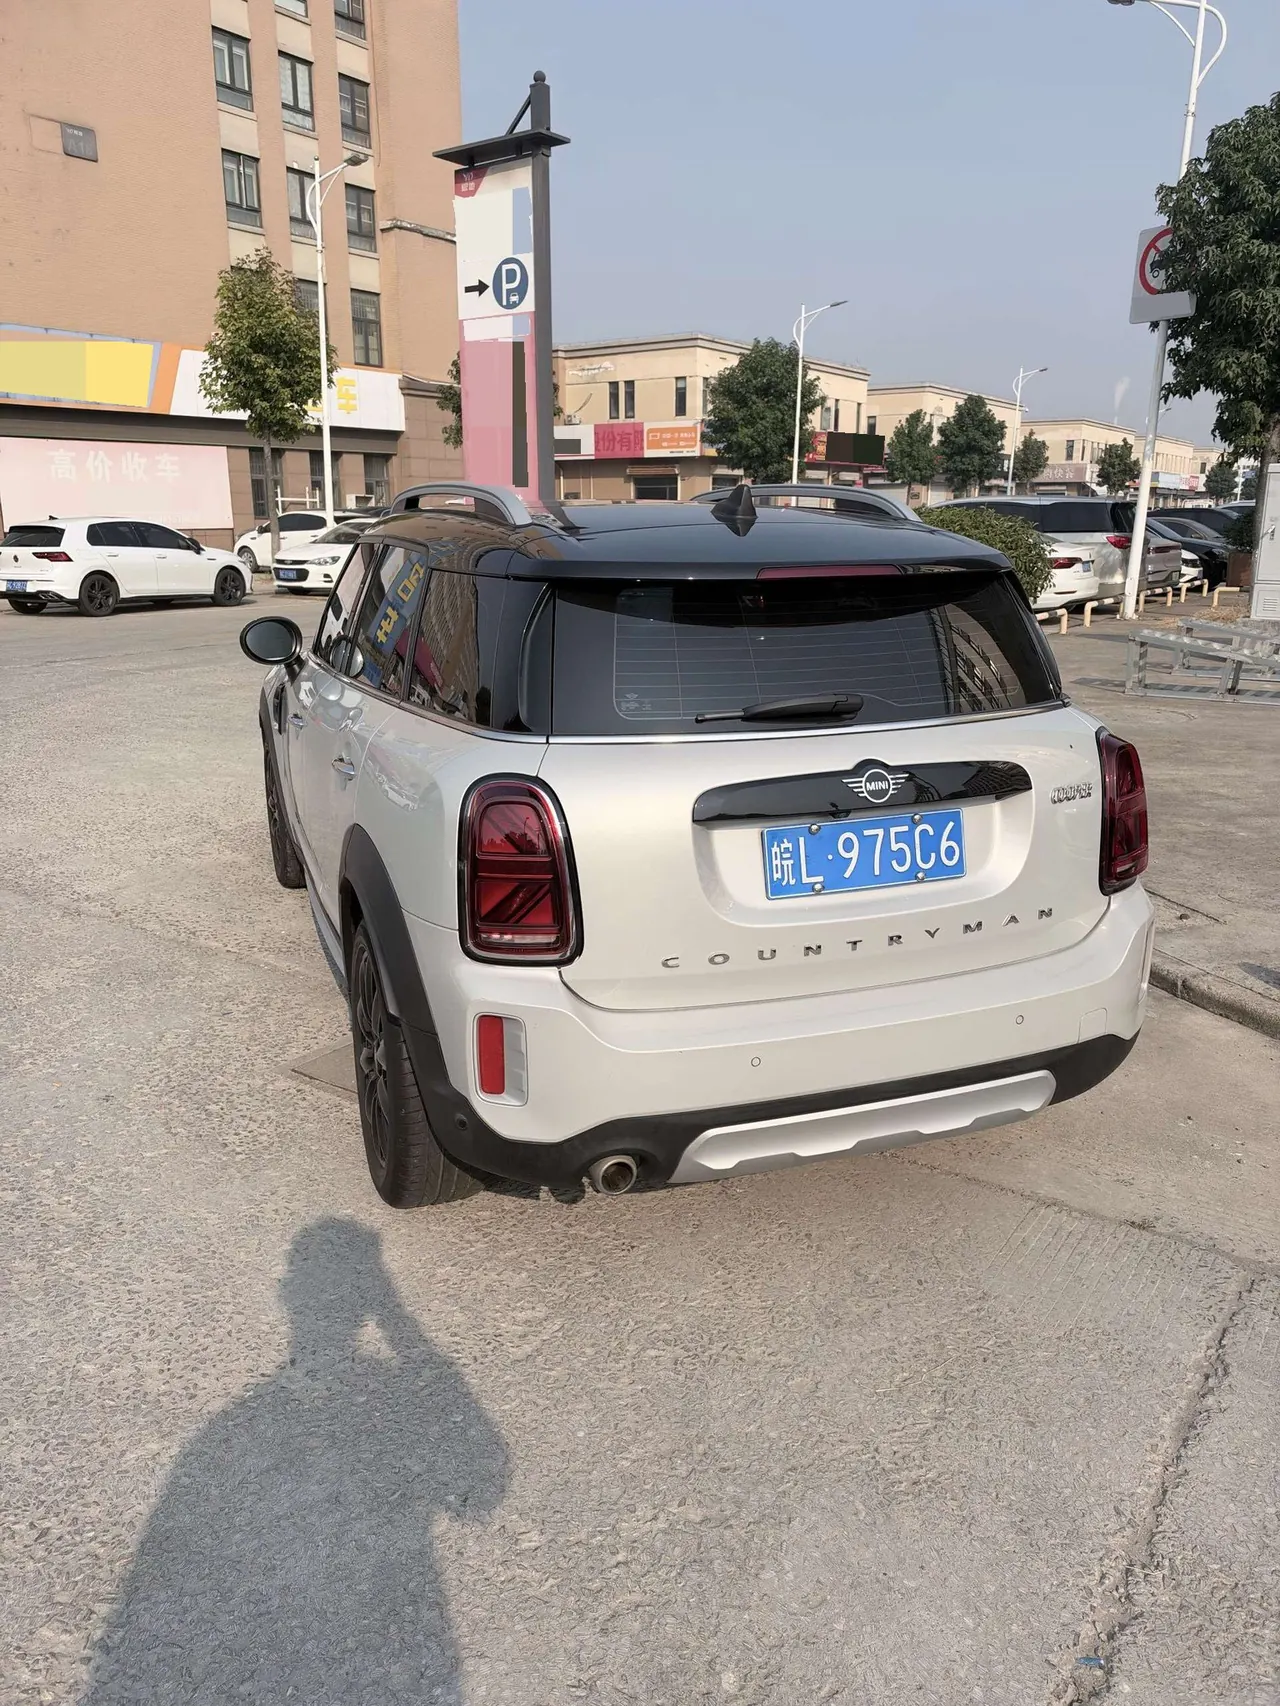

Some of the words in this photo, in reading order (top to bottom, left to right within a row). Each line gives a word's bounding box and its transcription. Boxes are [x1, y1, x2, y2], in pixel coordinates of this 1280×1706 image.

[502, 263, 521, 306] P
[48, 449, 181, 484] 高价收车
[866, 780, 889, 791] MINI
[771, 821, 960, 886] 皖L·975C6
[661, 907, 1054, 969] COUNTRYMAN
